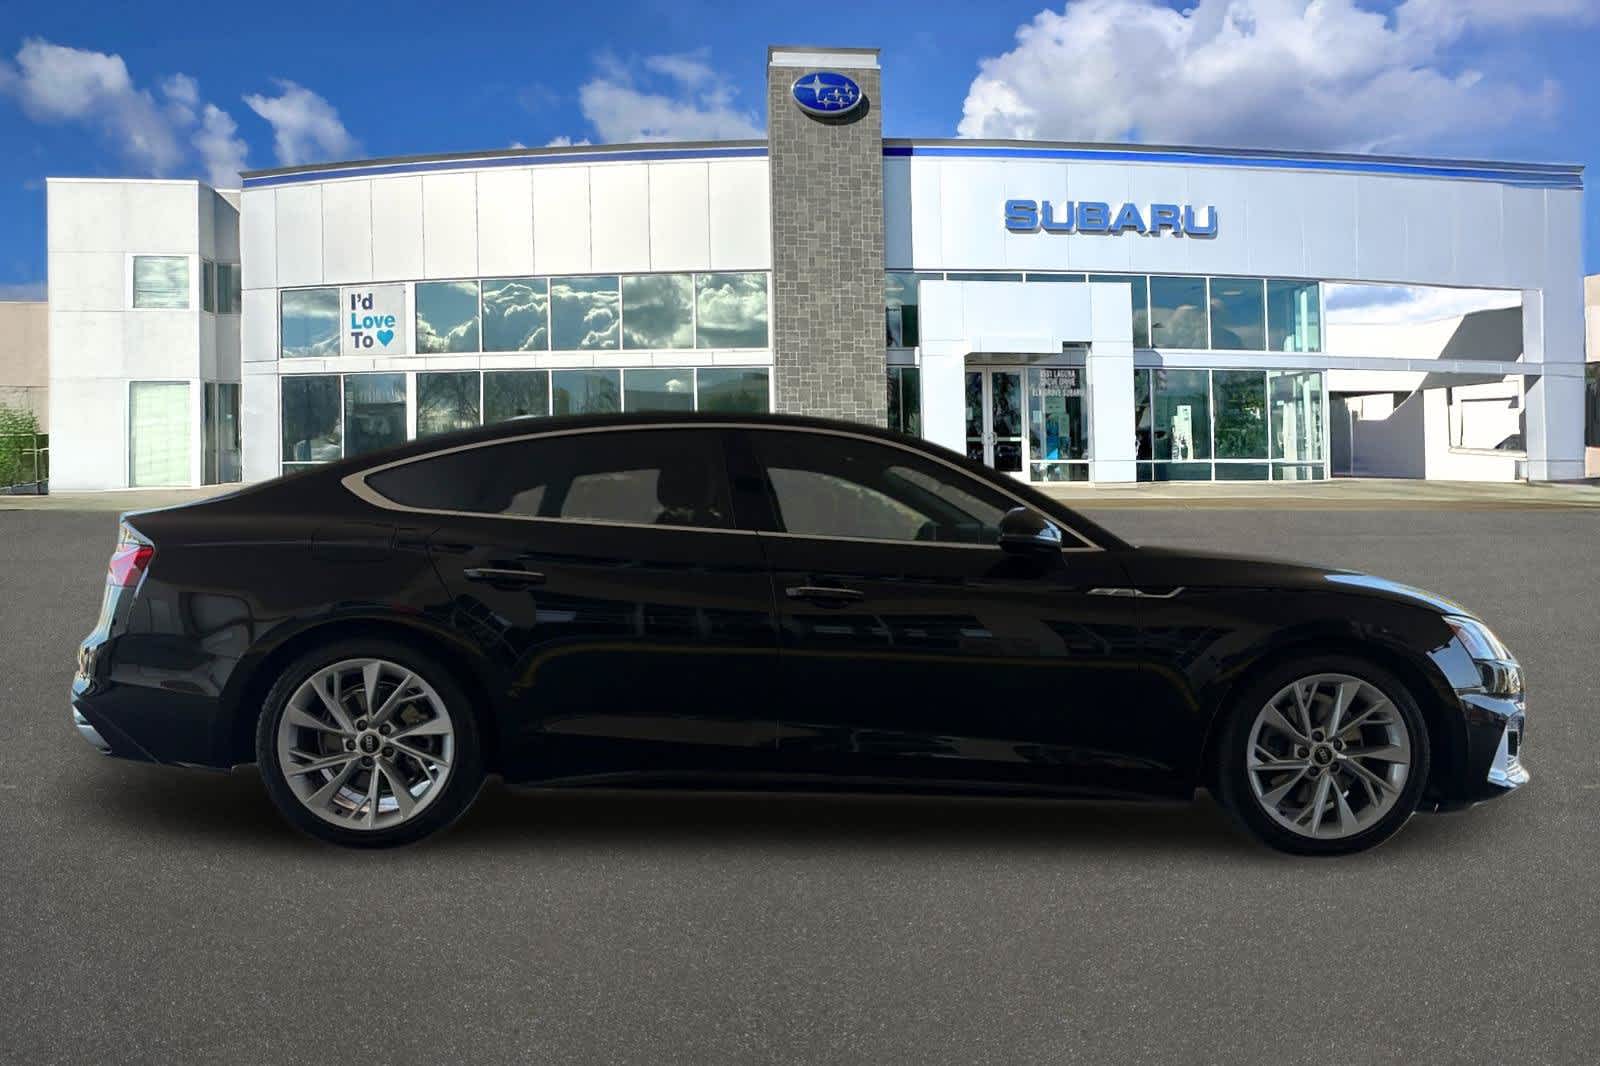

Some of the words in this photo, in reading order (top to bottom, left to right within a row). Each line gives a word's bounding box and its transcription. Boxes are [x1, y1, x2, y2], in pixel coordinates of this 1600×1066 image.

[1005, 199, 1217, 238] SUBARU
[350, 293, 373, 310] I'd
[351, 313, 396, 329] Love
[350, 332, 374, 348] To
